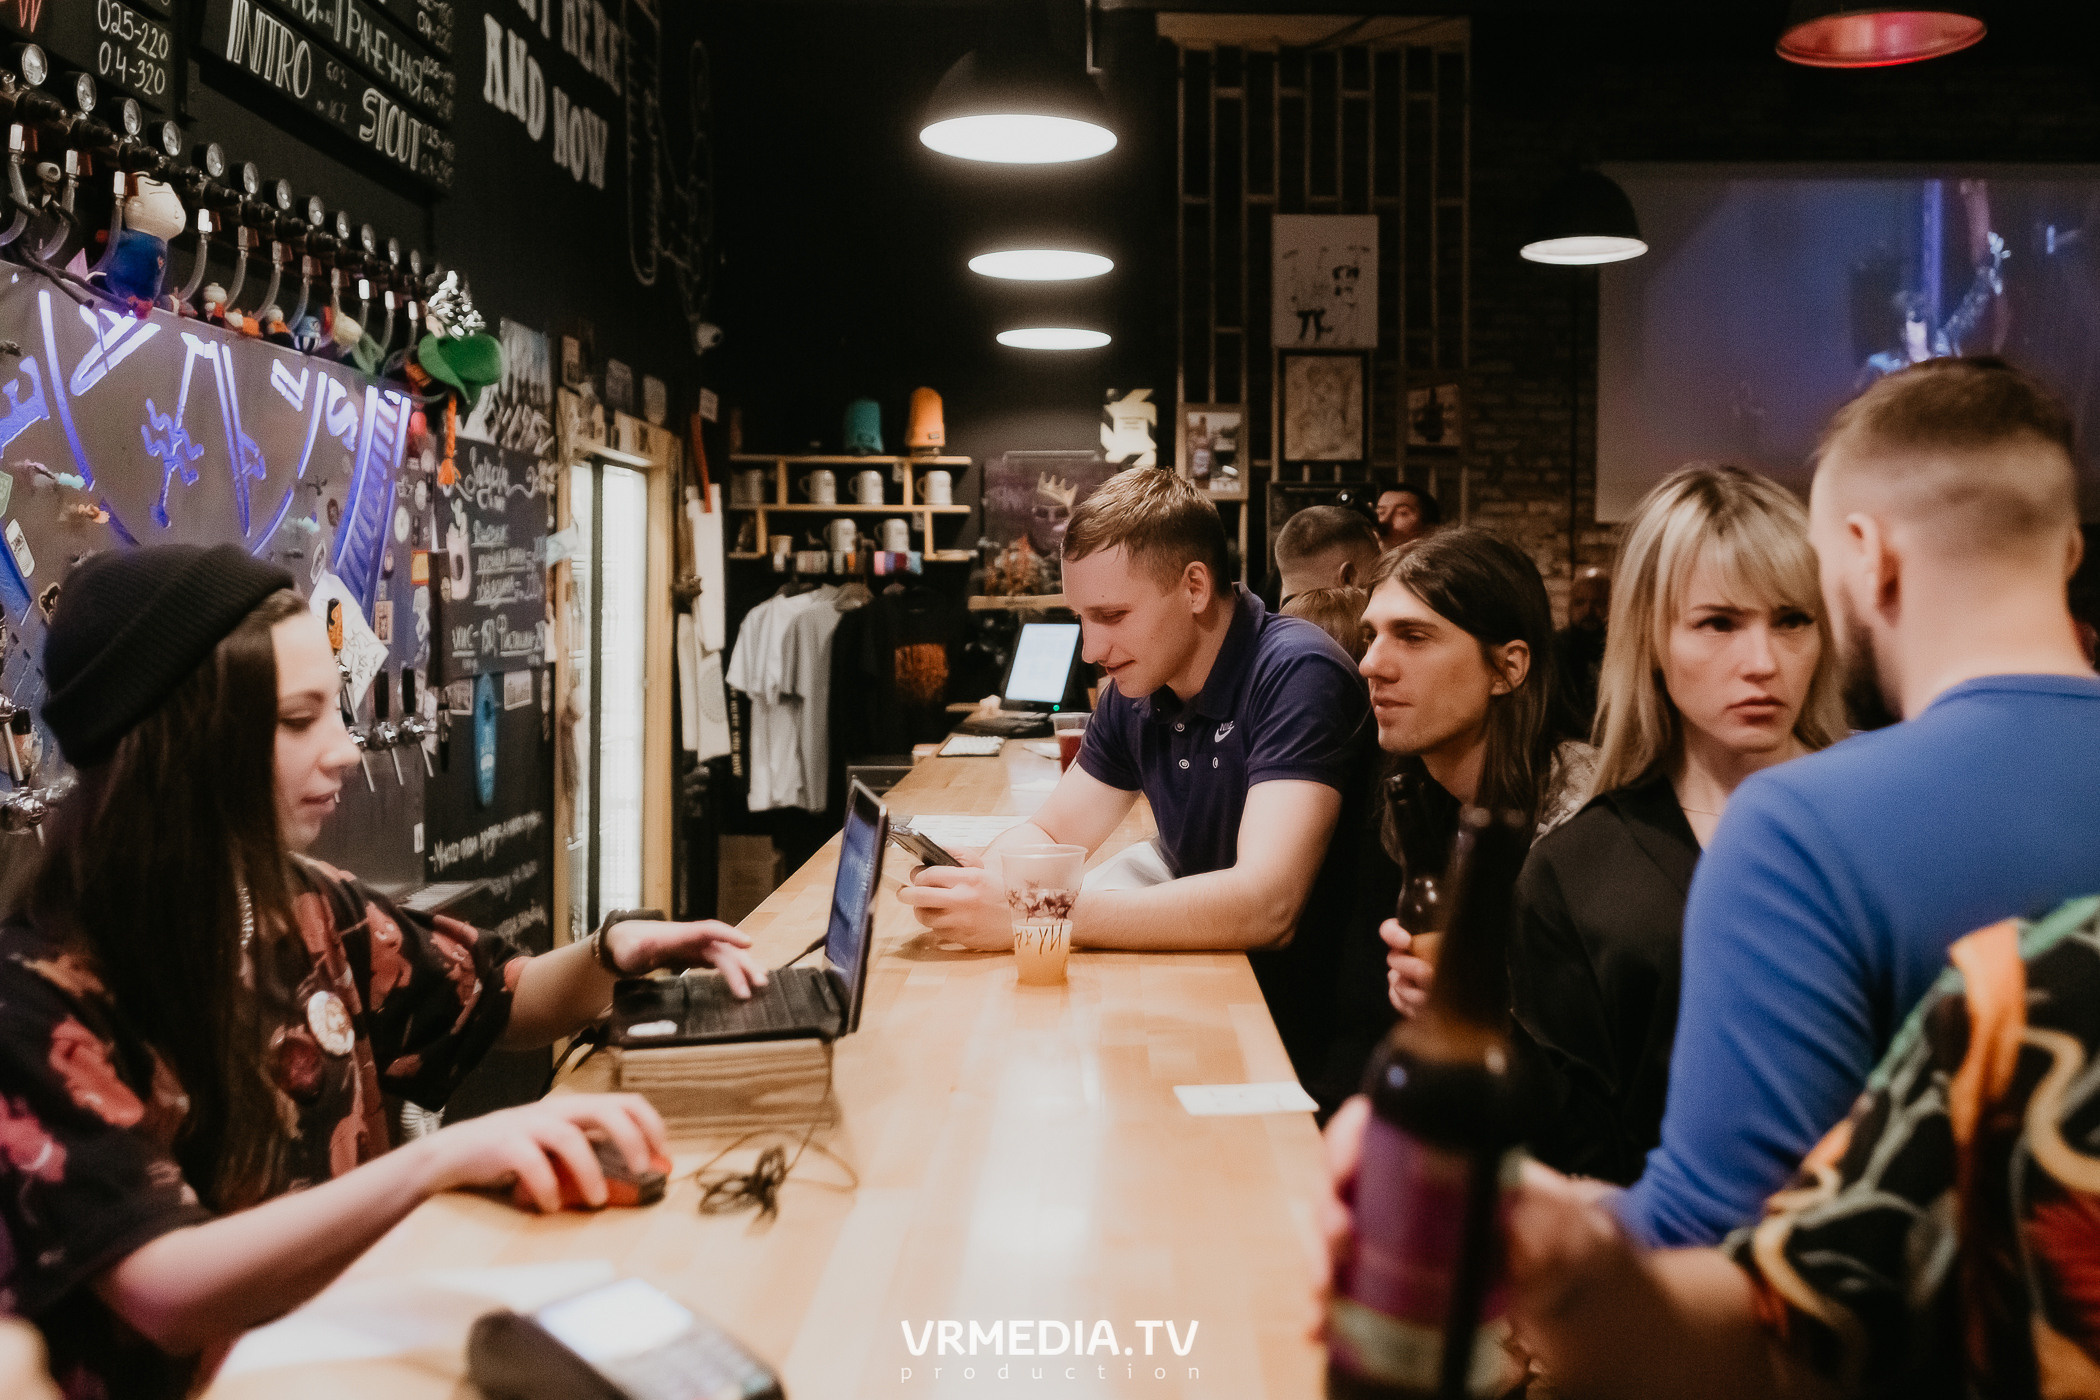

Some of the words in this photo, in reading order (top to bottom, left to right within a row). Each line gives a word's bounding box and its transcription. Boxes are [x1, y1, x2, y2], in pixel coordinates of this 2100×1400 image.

[225, 0, 312, 99] INTRO
[358, 87, 423, 172] STOUT
[483, 12, 547, 142] AND
[552, 85, 608, 190] NOW
